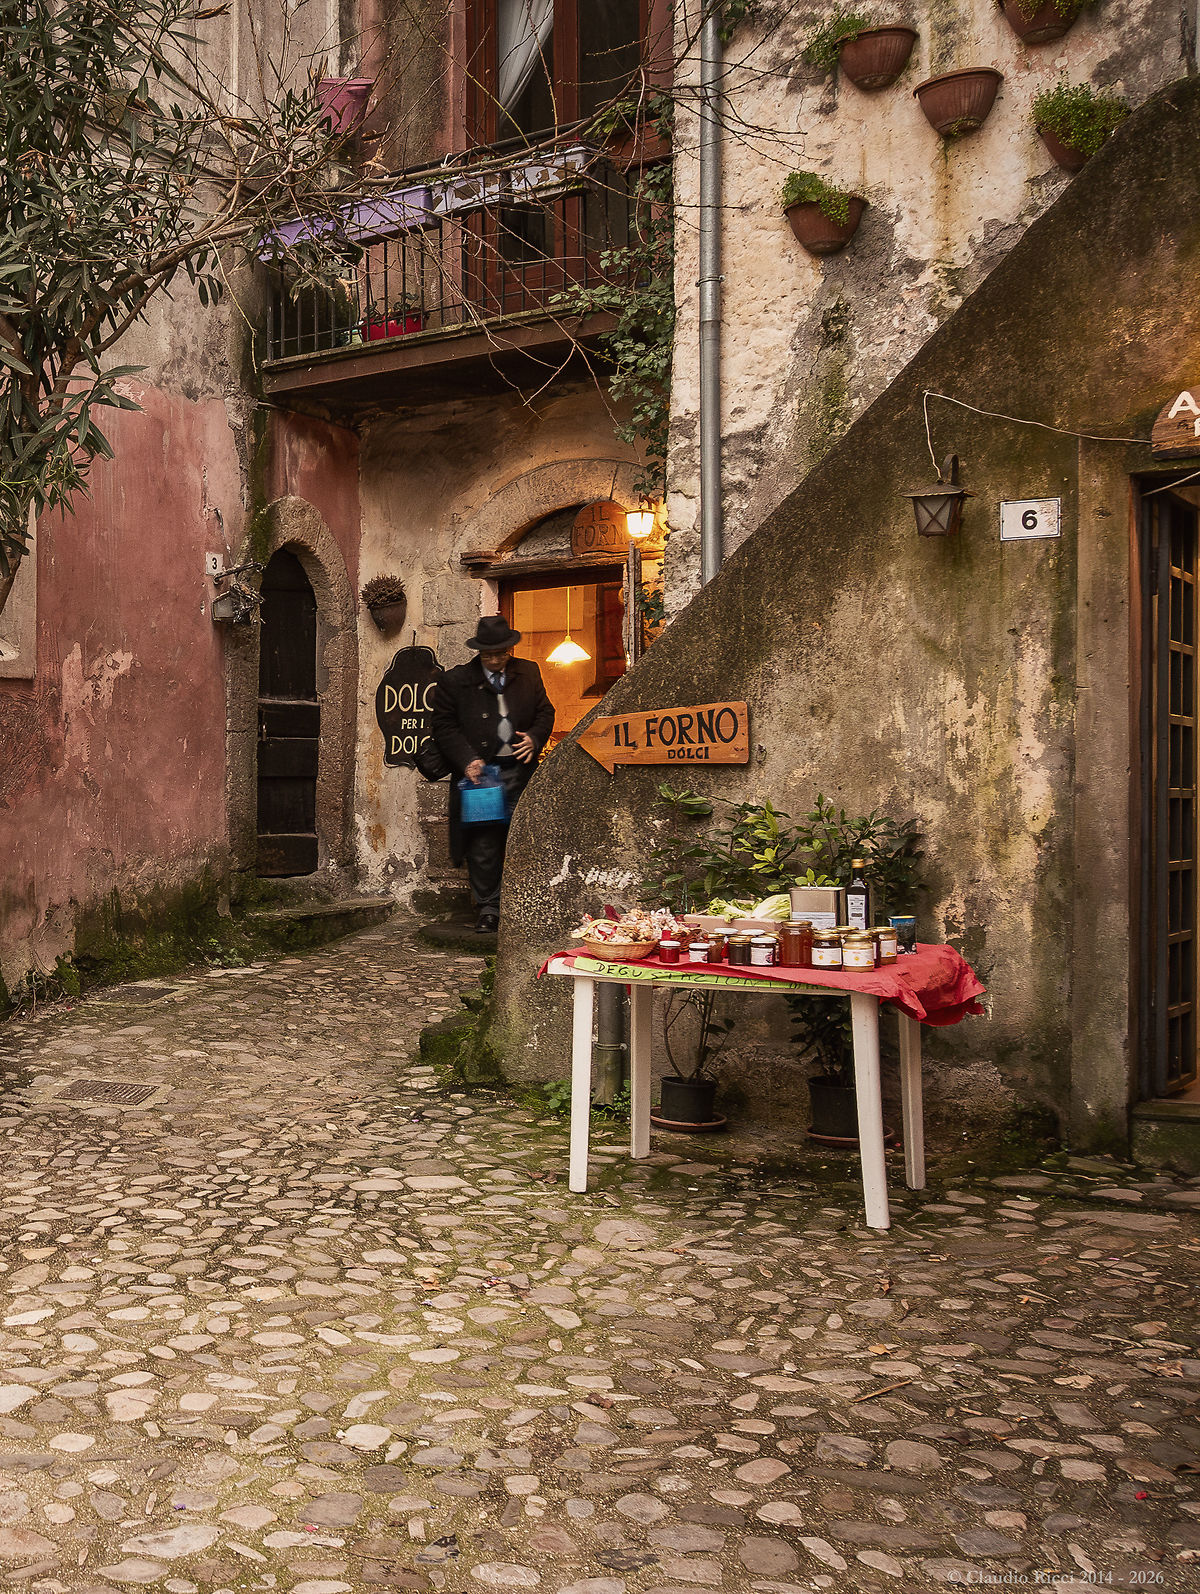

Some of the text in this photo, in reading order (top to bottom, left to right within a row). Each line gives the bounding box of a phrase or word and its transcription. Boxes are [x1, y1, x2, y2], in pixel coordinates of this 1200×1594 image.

[1168, 391, 1200, 420] A
[591, 505, 610, 522] IL
[1021, 509, 1038, 531] 6
[574, 524, 627, 547] FORN
[212, 557, 218, 570] 3
[384, 682, 438, 713] DOLC
[401, 718, 418, 730] PER
[614, 707, 738, 749] IL FORNO
[667, 746, 709, 760] DOLCI
